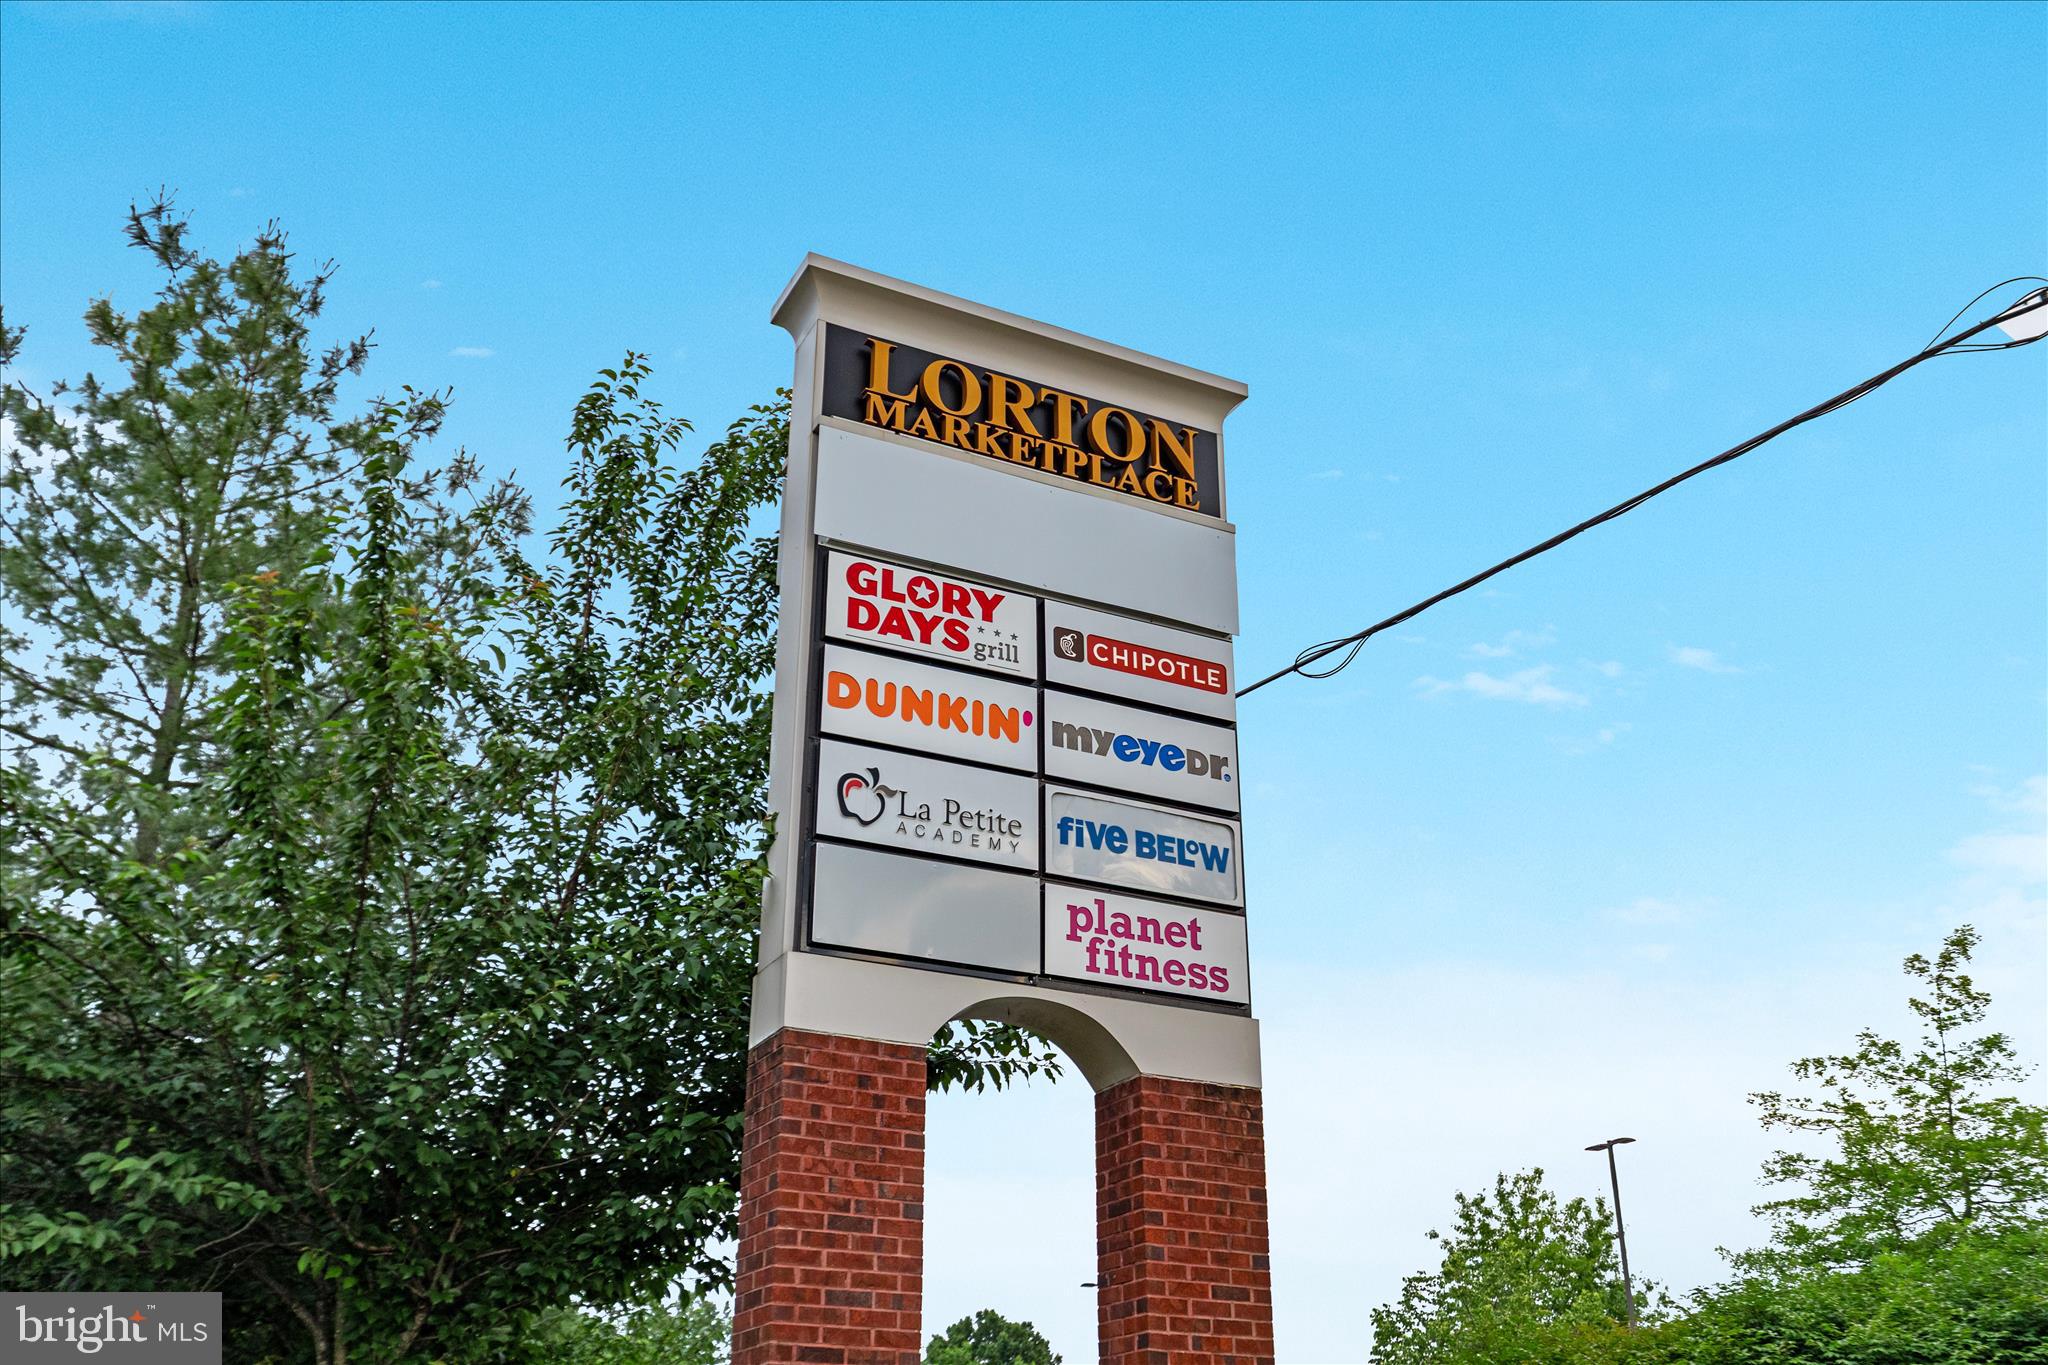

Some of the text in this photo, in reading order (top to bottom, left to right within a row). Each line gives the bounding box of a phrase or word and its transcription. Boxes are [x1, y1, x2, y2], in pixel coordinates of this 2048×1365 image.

[864, 337, 1199, 480] LORTON
[861, 389, 1200, 510] MARKETPLACE
[846, 562, 1005, 622] GLORY
[847, 596, 970, 652] DAYS
[974, 642, 1019, 664] grill
[1093, 643, 1221, 688] CHIPOTLE
[827, 670, 1032, 743] DUNKIN'
[896, 821, 1020, 853] ACADEMY
[898, 791, 1022, 837] La Petite
[1066, 898, 1202, 951] planet
[1086, 937, 1229, 993] fitness
